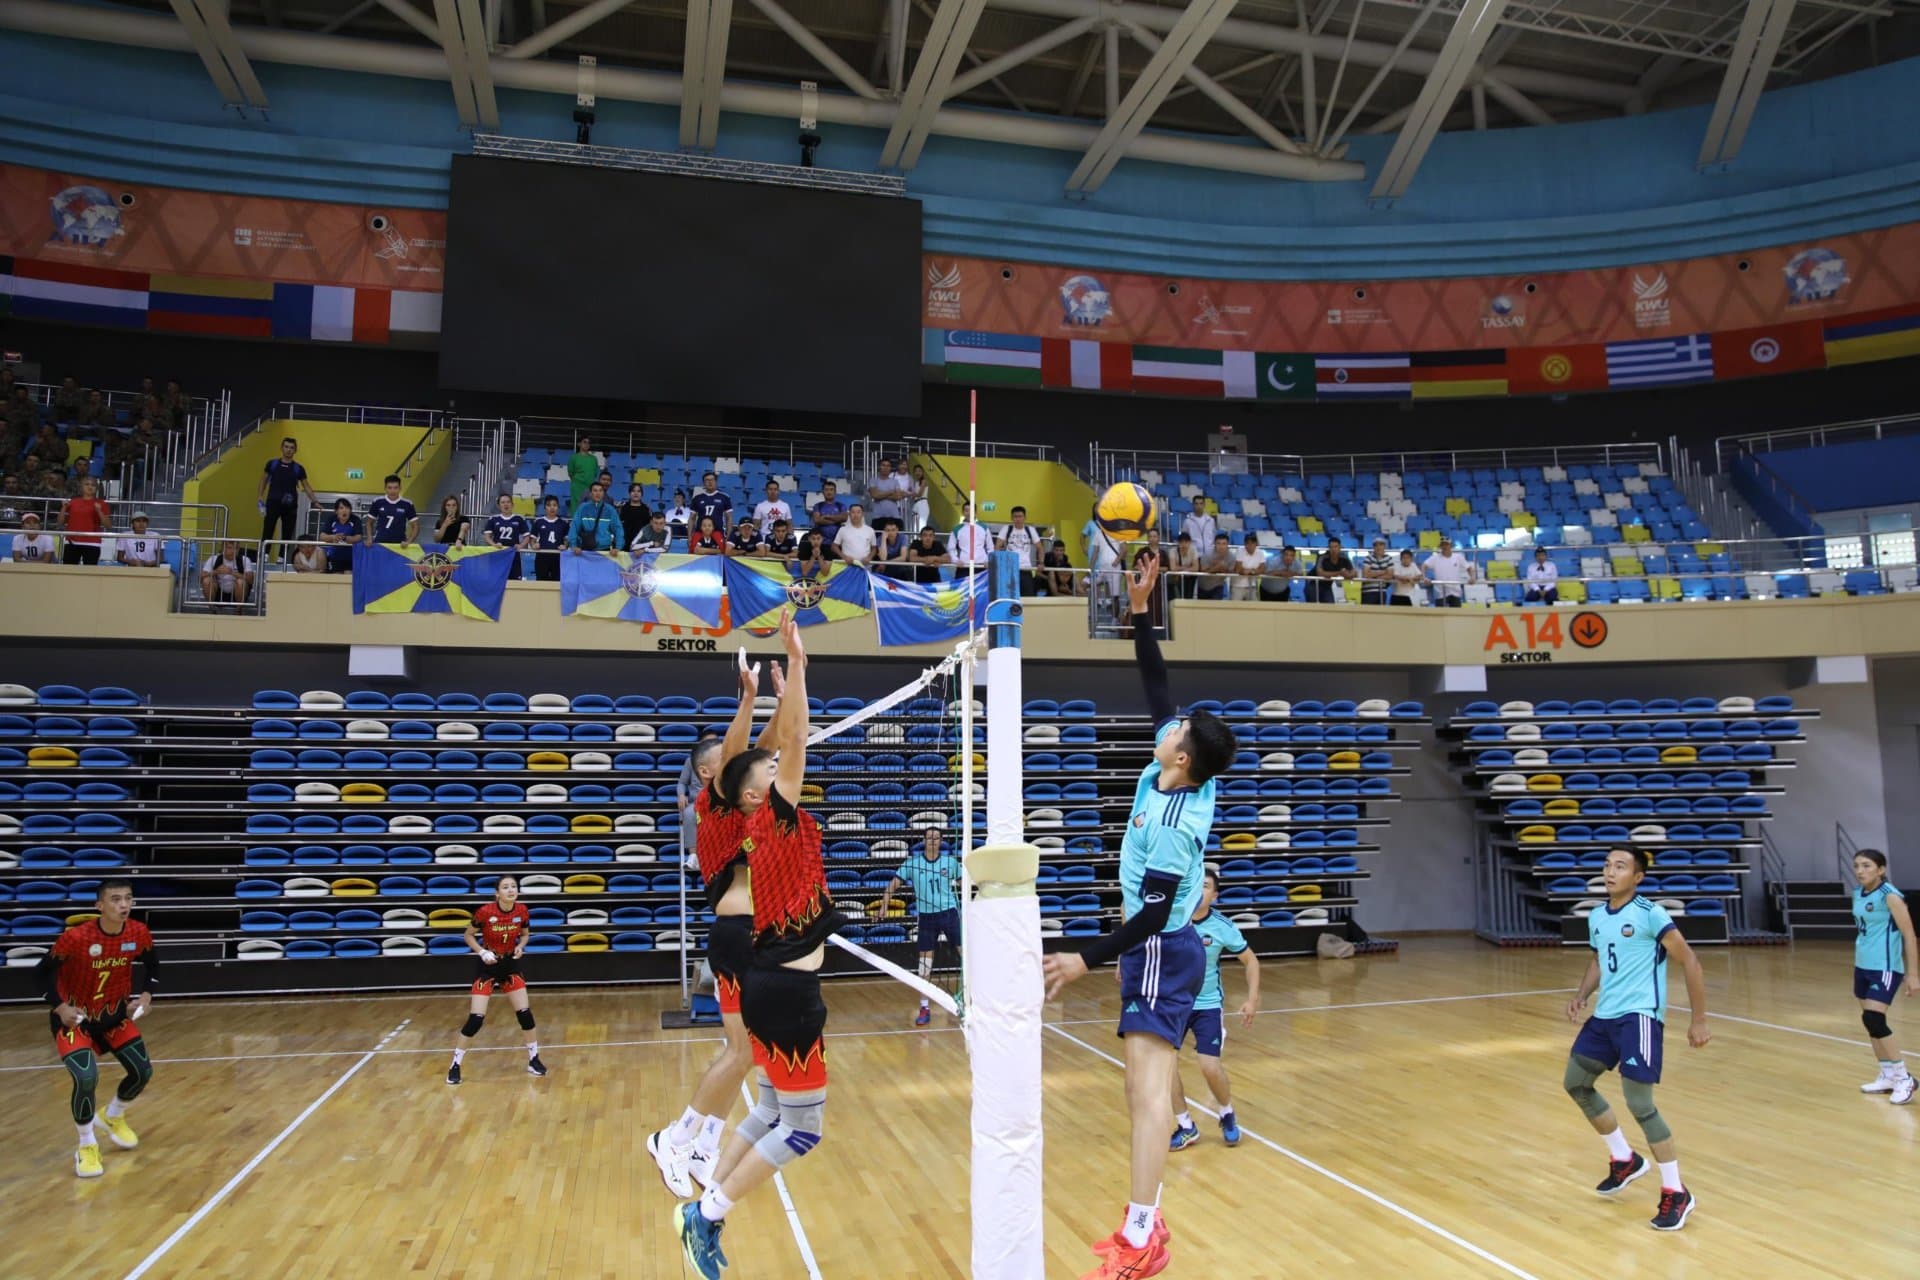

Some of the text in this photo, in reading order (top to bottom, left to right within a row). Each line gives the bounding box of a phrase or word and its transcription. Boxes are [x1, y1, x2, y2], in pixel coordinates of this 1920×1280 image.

[928, 290, 960, 301] KWU
[1635, 299, 1669, 312] KWU
[1481, 315, 1526, 328] TASSAY
[705, 505, 715, 516] 17
[385, 515, 394, 529] 7
[499, 526, 513, 539] 22
[547, 531, 556, 543] 4
[25, 546, 38, 557] 10
[134, 541, 146, 552] 19
[1484, 612, 1563, 650] A14
[657, 638, 717, 651] SEKTOR
[1500, 652, 1552, 664] SEKTOR
[929, 879, 940, 894] 11
[1607, 943, 1618, 973] 5
[96, 971, 111, 993] 7
